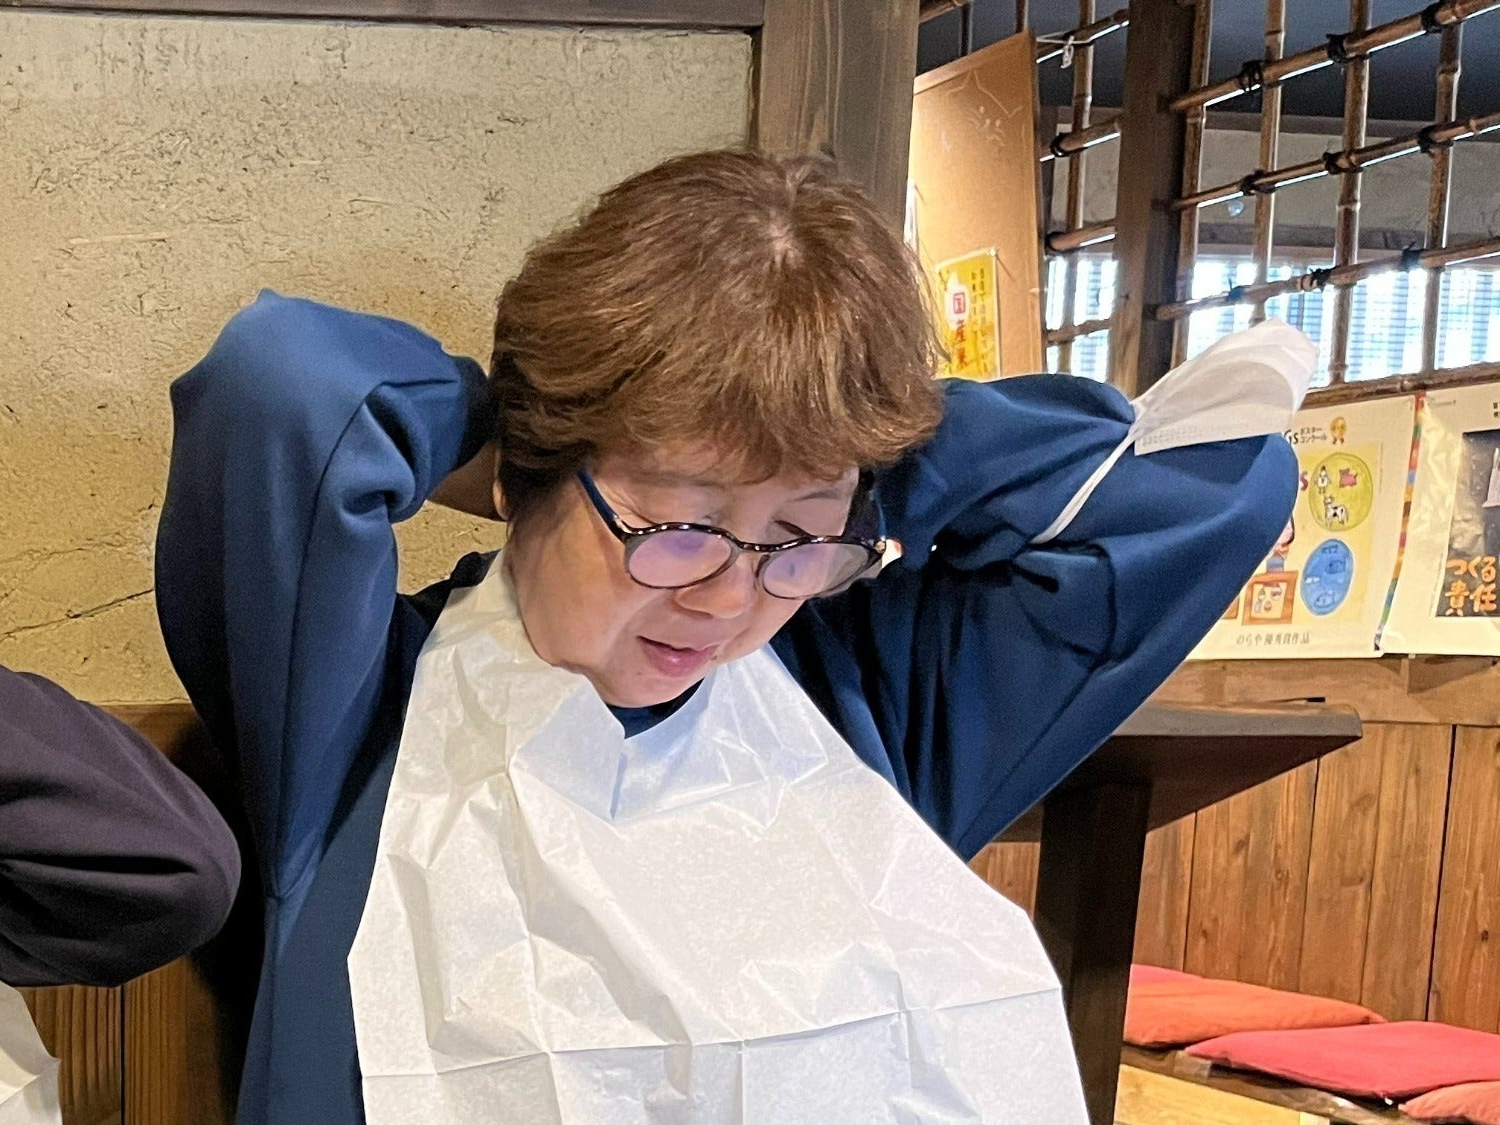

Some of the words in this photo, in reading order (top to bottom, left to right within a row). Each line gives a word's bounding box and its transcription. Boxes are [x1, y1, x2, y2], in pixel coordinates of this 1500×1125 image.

[1446, 555, 1497, 582] つくる
[1445, 579, 1498, 617] 責任
